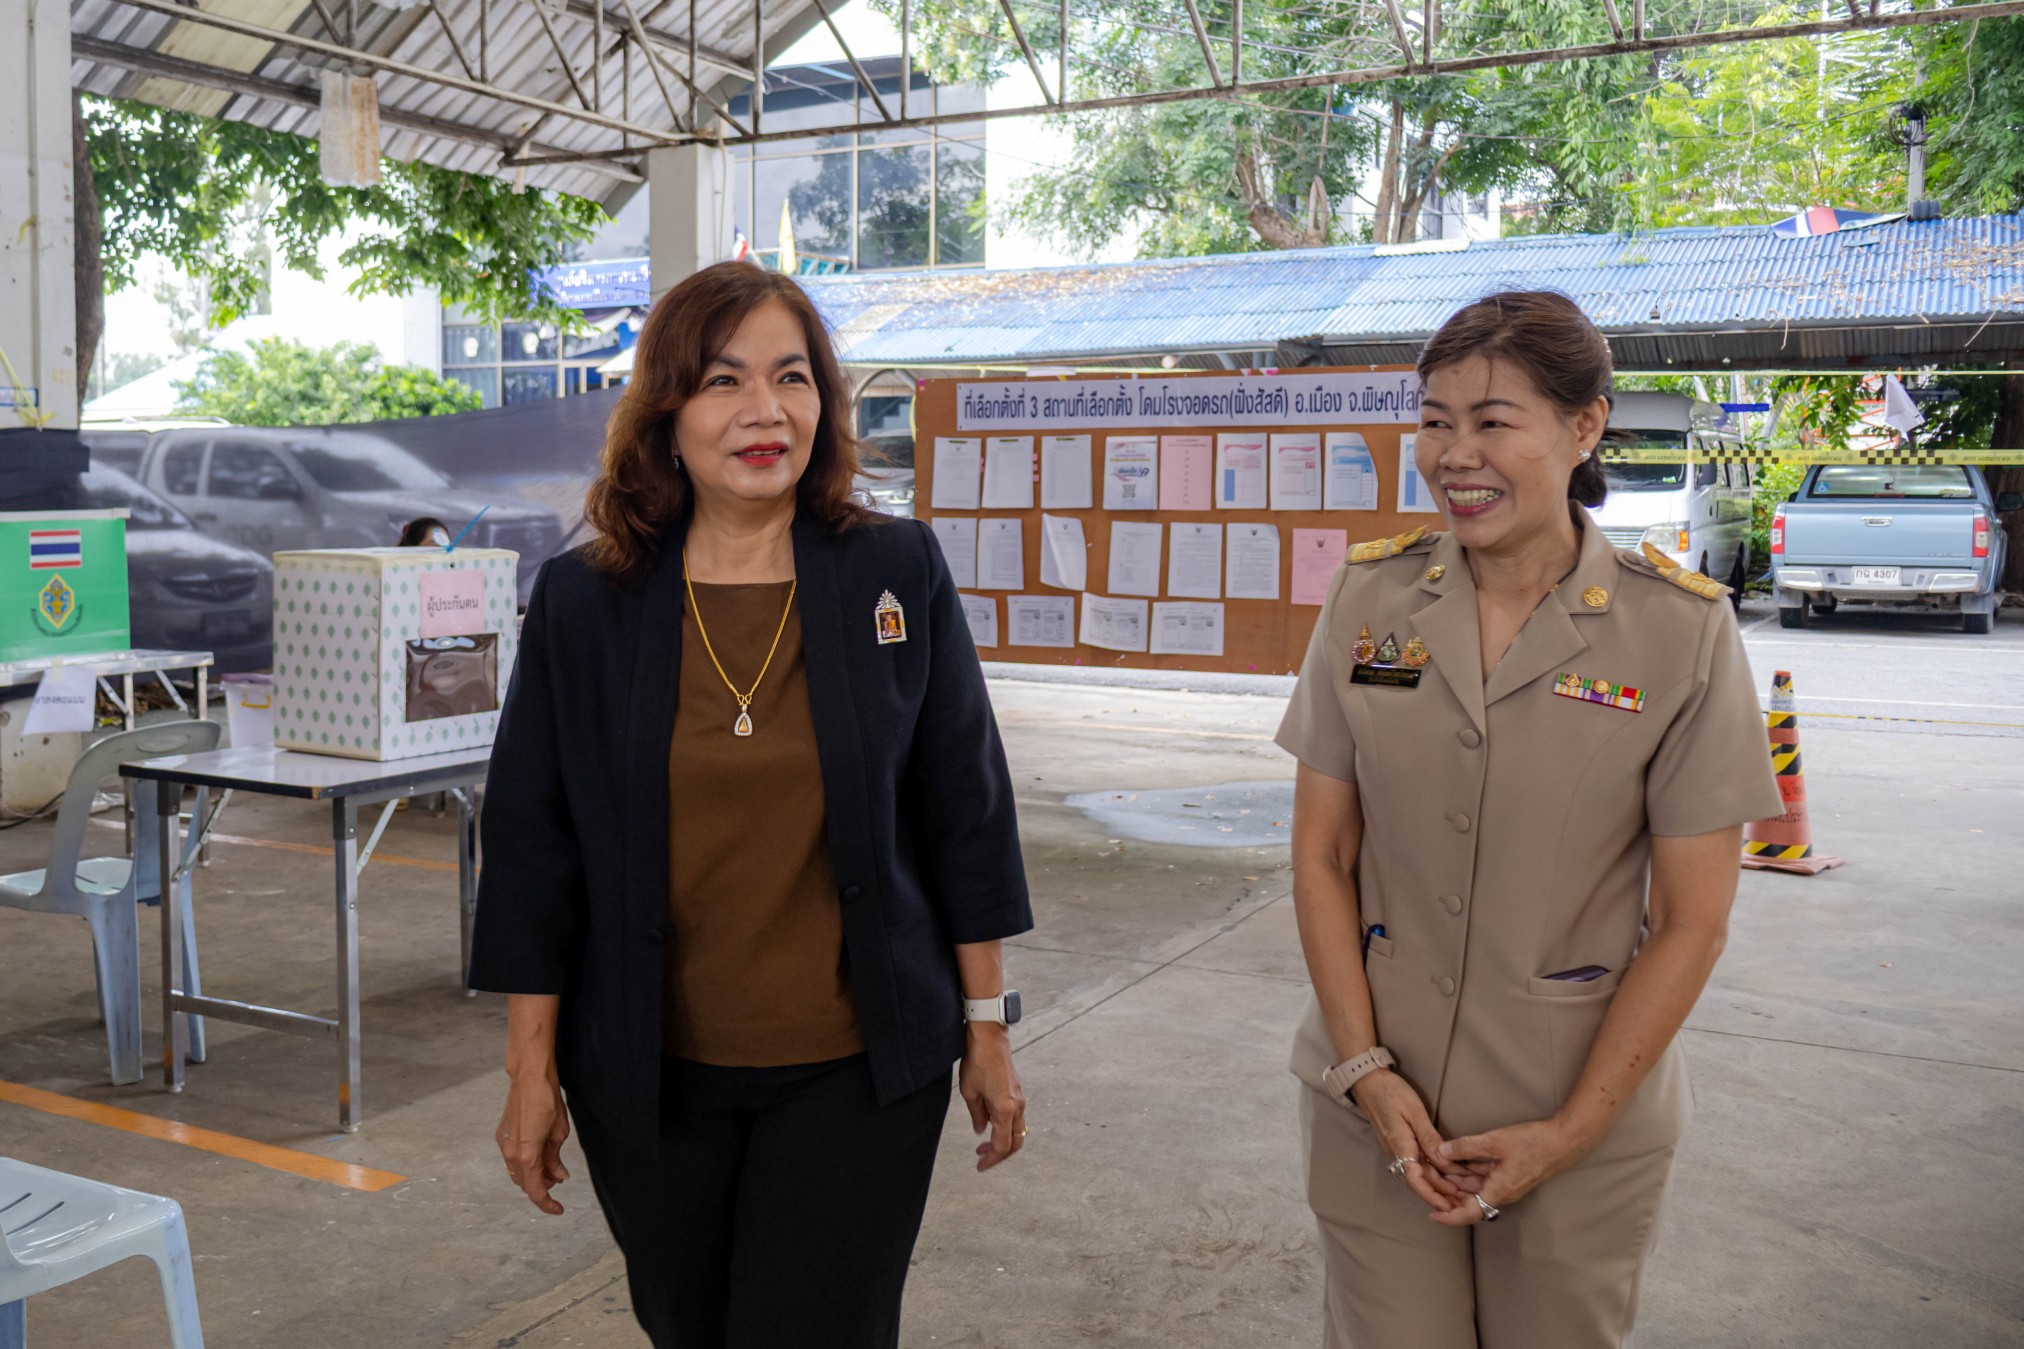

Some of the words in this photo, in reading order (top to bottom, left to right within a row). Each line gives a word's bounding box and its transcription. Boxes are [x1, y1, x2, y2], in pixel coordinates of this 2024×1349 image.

[964, 387, 1026, 420] ที่เลือกตั้งที่
[1030, 396, 1039, 419] 3
[1043, 385, 1133, 419] สถานที่เลือกตั้ง
[1295, 385, 1342, 414] อ.เมือง
[1873, 570, 1897, 579] 4307
